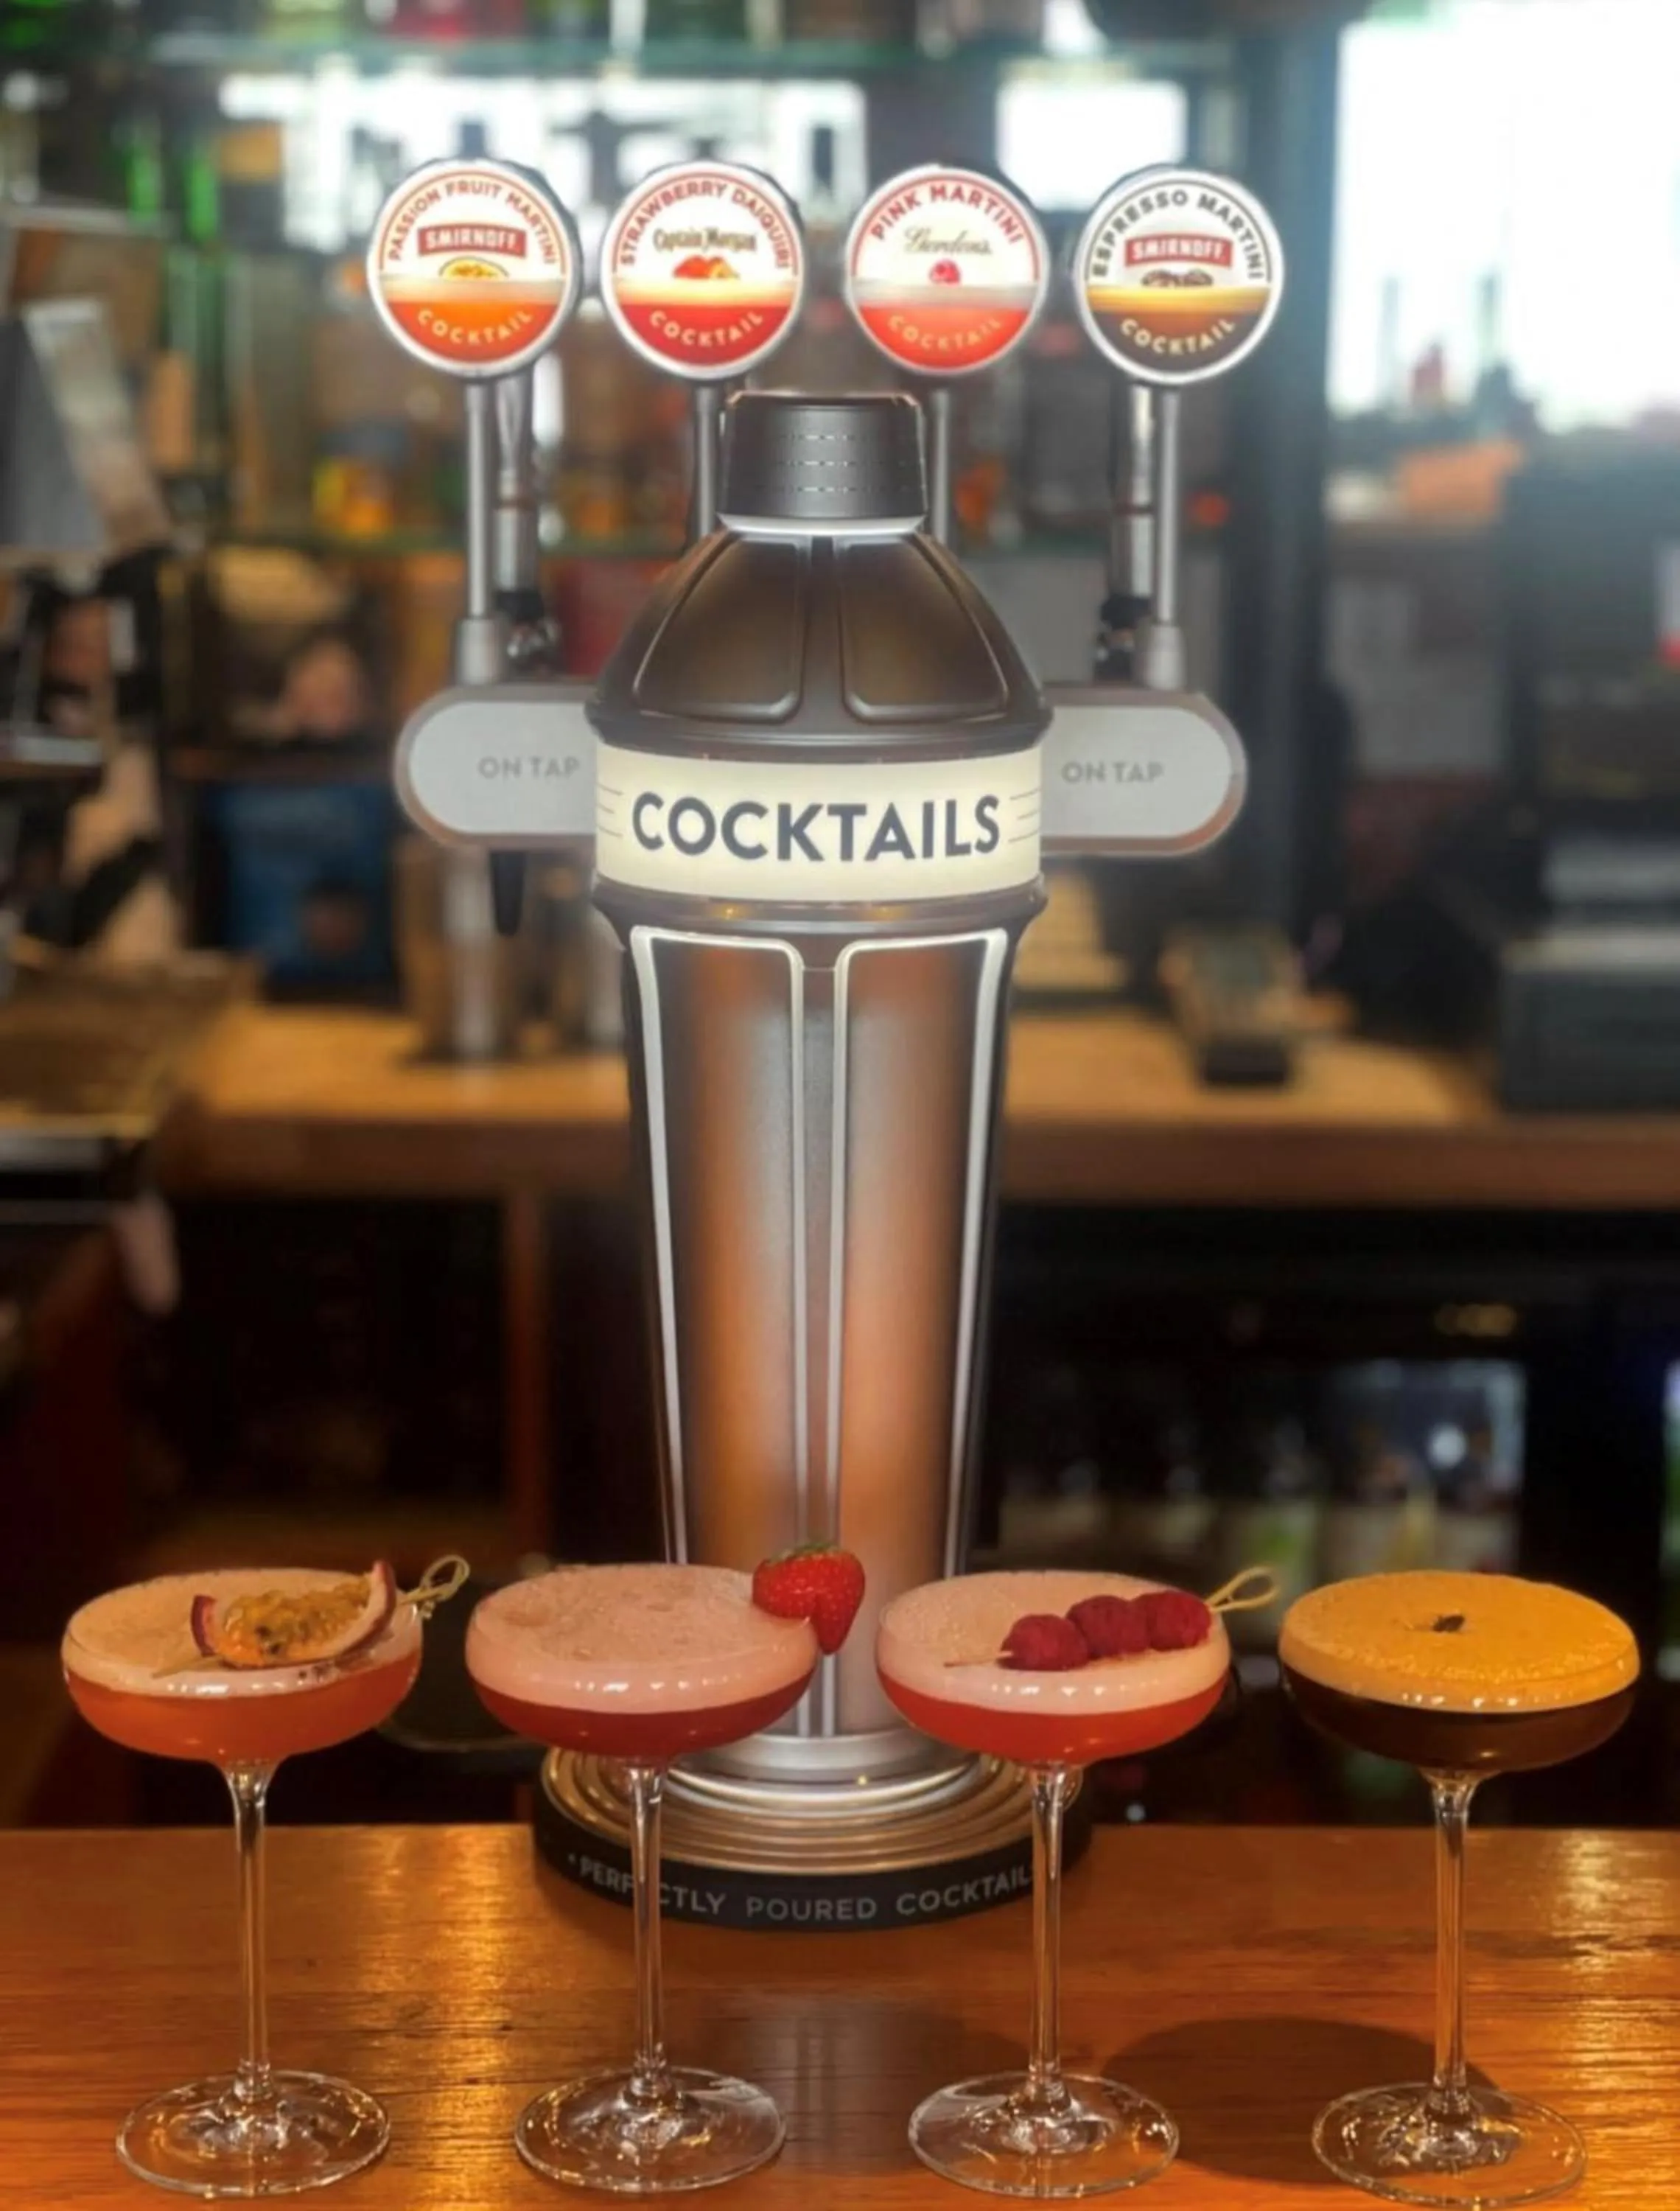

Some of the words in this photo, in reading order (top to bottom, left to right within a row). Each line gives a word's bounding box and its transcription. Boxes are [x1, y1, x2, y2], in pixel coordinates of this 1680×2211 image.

[389, 187, 441, 261] PASSION
[445, 180, 503, 198] FRUIT
[506, 192, 557, 265] MARTINI
[620, 180, 728, 266] STRAWBERRY
[731, 187, 790, 269] DAIQUIRI
[871, 191, 922, 241] PINK
[931, 184, 1024, 245] MARTINI
[425, 228, 519, 252] SMIRNOFF
[1092, 189, 1189, 277] ESPRESSO
[1197, 193, 1264, 279] MARTINI
[1132, 237, 1228, 262] SMIRNOFF
[418, 307, 533, 345] COCKTAIL
[650, 310, 763, 347] COCKTAIL
[888, 314, 1002, 352] COCKTAIL
[1121, 318, 1236, 354] COCKTAIL
[477, 755, 520, 780] ON
[528, 755, 581, 779] TAP
[1061, 761, 1105, 784] ON
[1112, 761, 1164, 783] TAP
[632, 791, 999, 862] COCKTAILS
[579, 1855, 727, 1915] PERFCTLY
[746, 1896, 878, 1921] POURED
